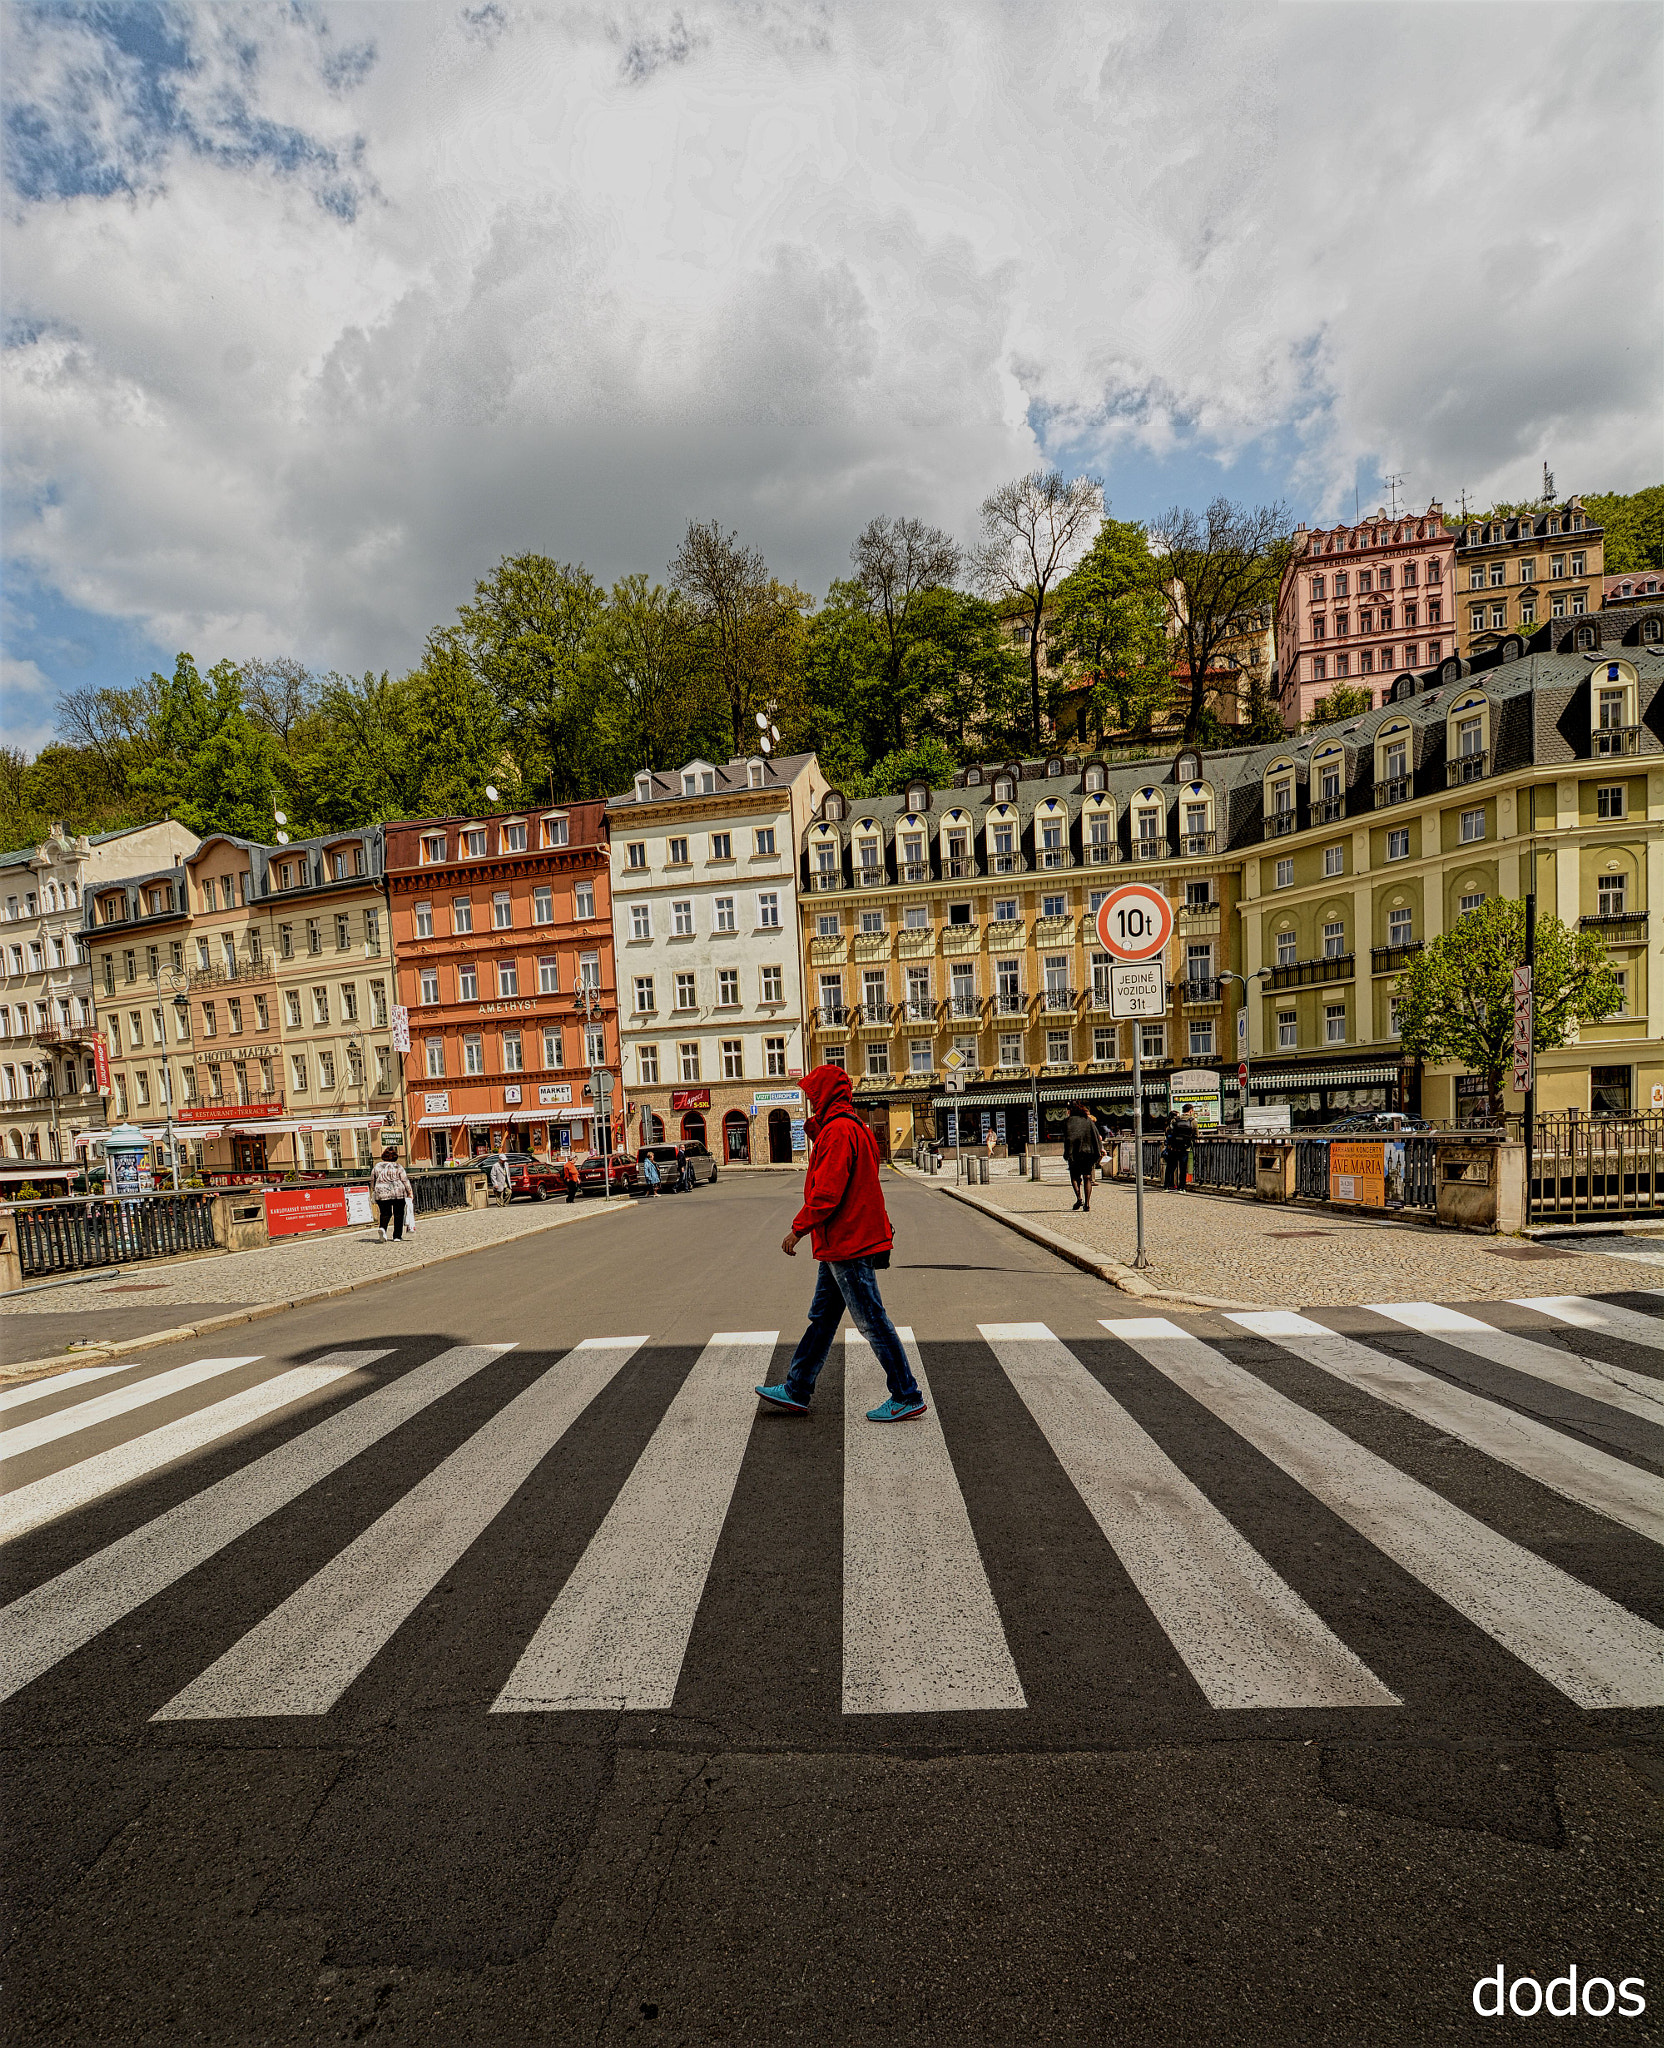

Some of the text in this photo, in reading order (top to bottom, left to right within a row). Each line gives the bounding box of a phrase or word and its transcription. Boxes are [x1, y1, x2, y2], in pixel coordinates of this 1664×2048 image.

[1323, 547, 1427, 568] PENSION AMADEUS
[1117, 908, 1153, 938] 10t
[1119, 971, 1154, 985] JEDINÉ
[1117, 985, 1157, 996] VOZIDLO
[478, 999, 538, 1015] AMETHYST
[1129, 998, 1146, 1010] 31t
[97, 1045, 105, 1062] SHOP
[204, 1049, 236, 1062] HOTEL
[540, 1086, 570, 1094] MARKET
[673, 1089, 704, 1110] Aspect
[195, 1109, 234, 1118] RESTAURANT
[237, 1106, 265, 1115] TERRACE
[562, 1131, 567, 1142] P
[1356, 1146, 1383, 1154] KONCERTY
[1332, 1158, 1382, 1175] AVE MARIA
